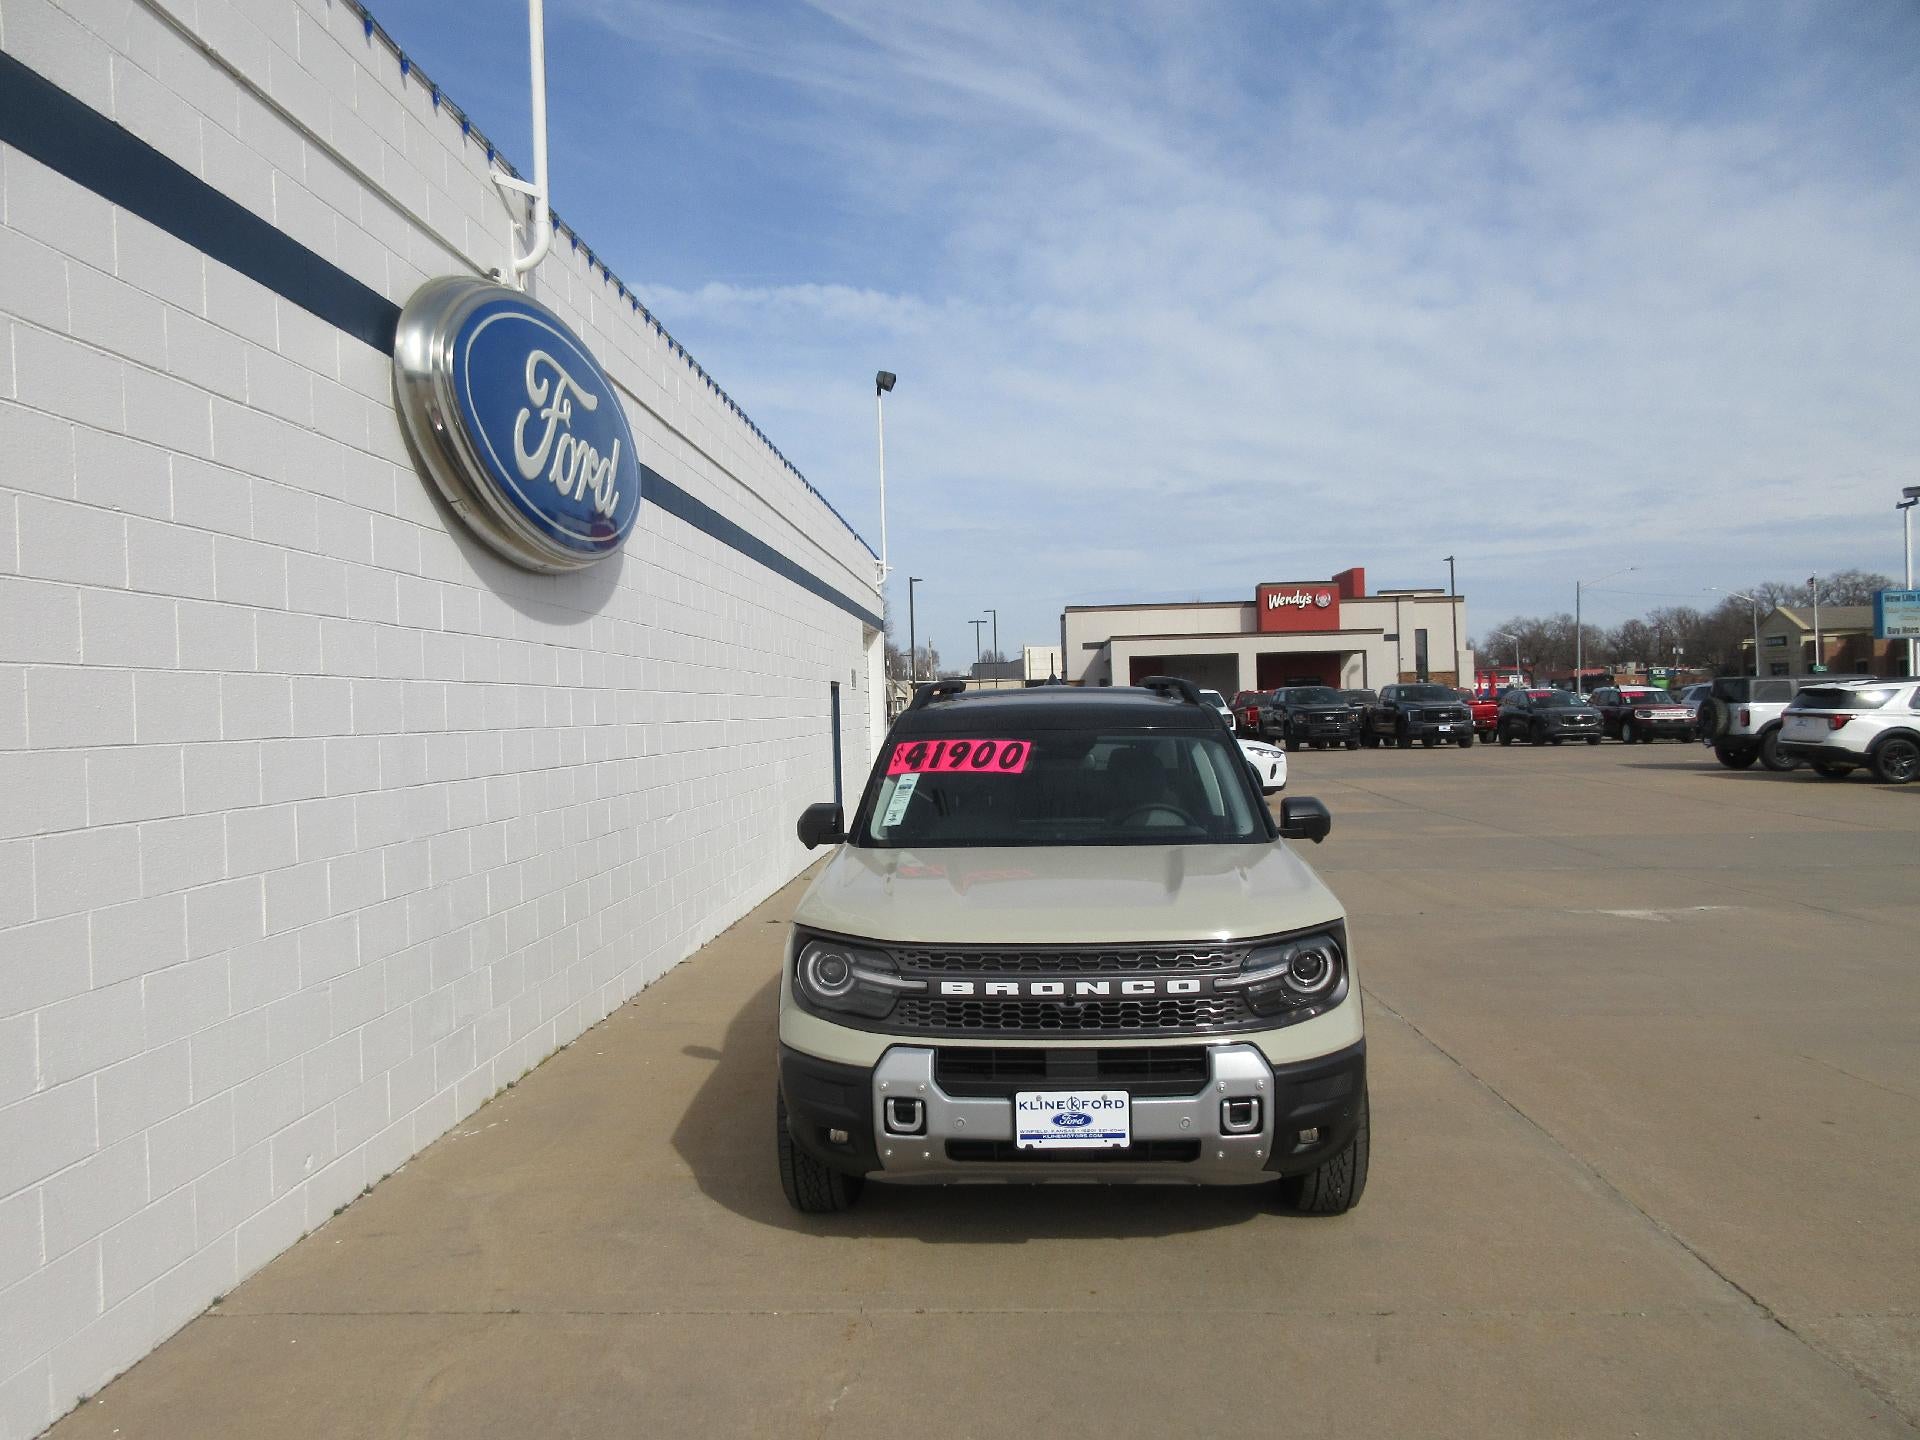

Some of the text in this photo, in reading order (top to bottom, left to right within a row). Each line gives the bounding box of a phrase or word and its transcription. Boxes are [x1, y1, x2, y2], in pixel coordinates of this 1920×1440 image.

[513, 349, 621, 517] Ford
[1268, 589, 1313, 610] Wendy's
[893, 741, 1024, 770] $41900
[940, 980, 1201, 996] BRONCO
[1019, 1101, 1066, 1111] KLINE
[1081, 1100, 1125, 1110] FORD
[1059, 1112, 1085, 1125] Ford
